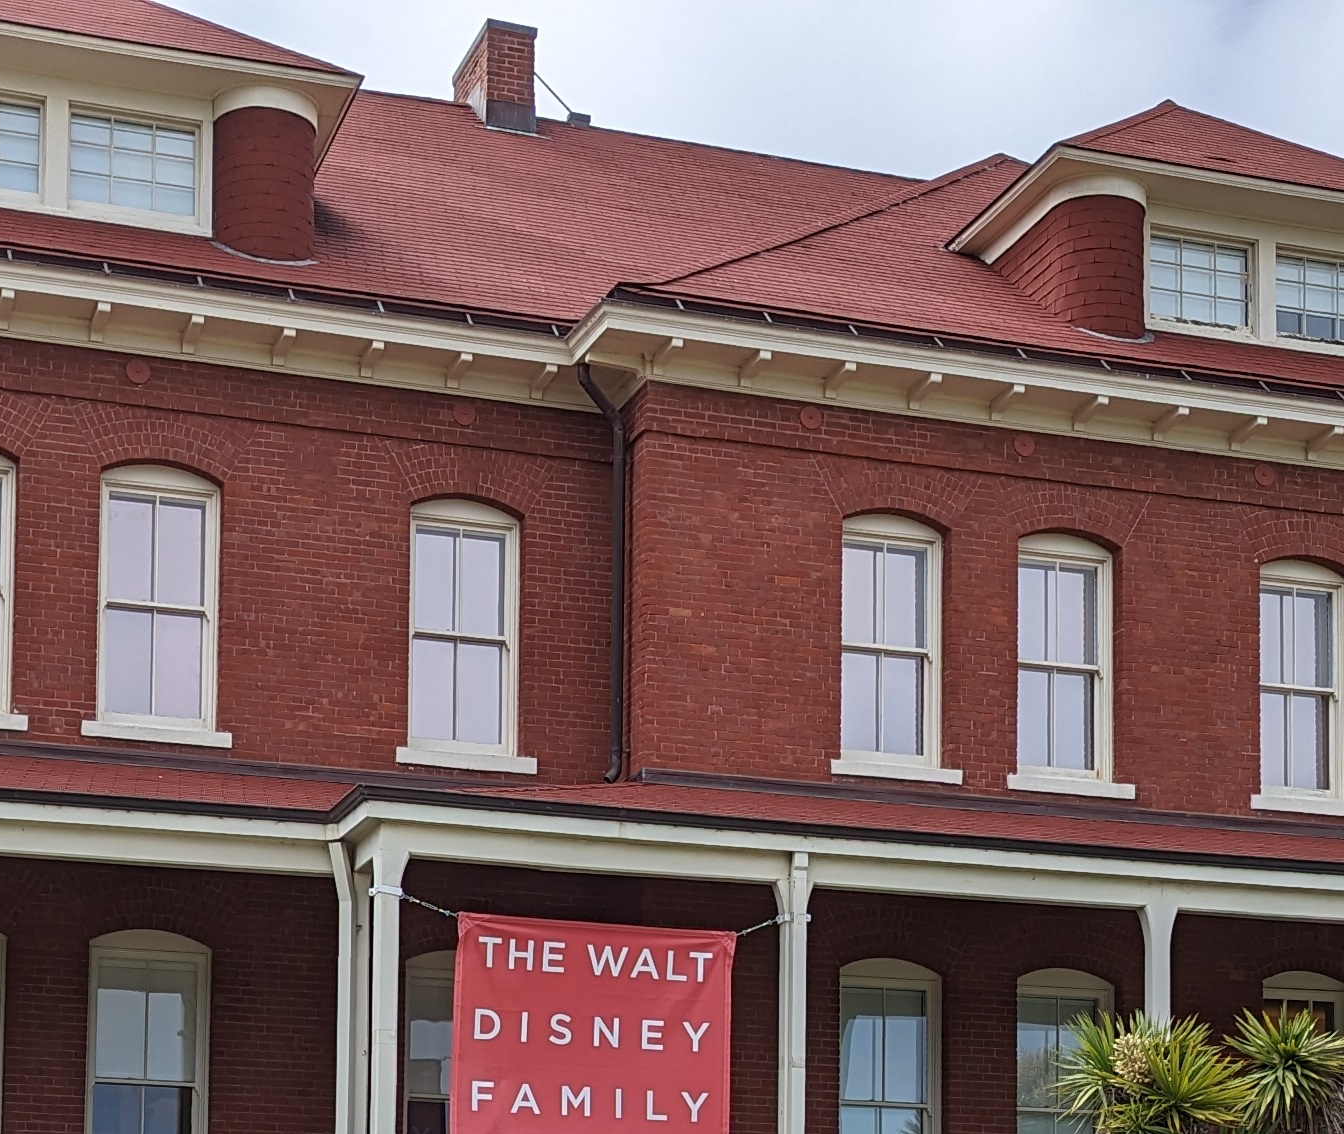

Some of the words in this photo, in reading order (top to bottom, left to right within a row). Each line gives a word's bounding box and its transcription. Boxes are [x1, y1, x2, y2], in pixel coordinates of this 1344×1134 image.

[478, 936, 565, 973] THE
[587, 944, 713, 982] WALT
[473, 1008, 710, 1052] DISNEY
[471, 1080, 709, 1123] FAMILY
